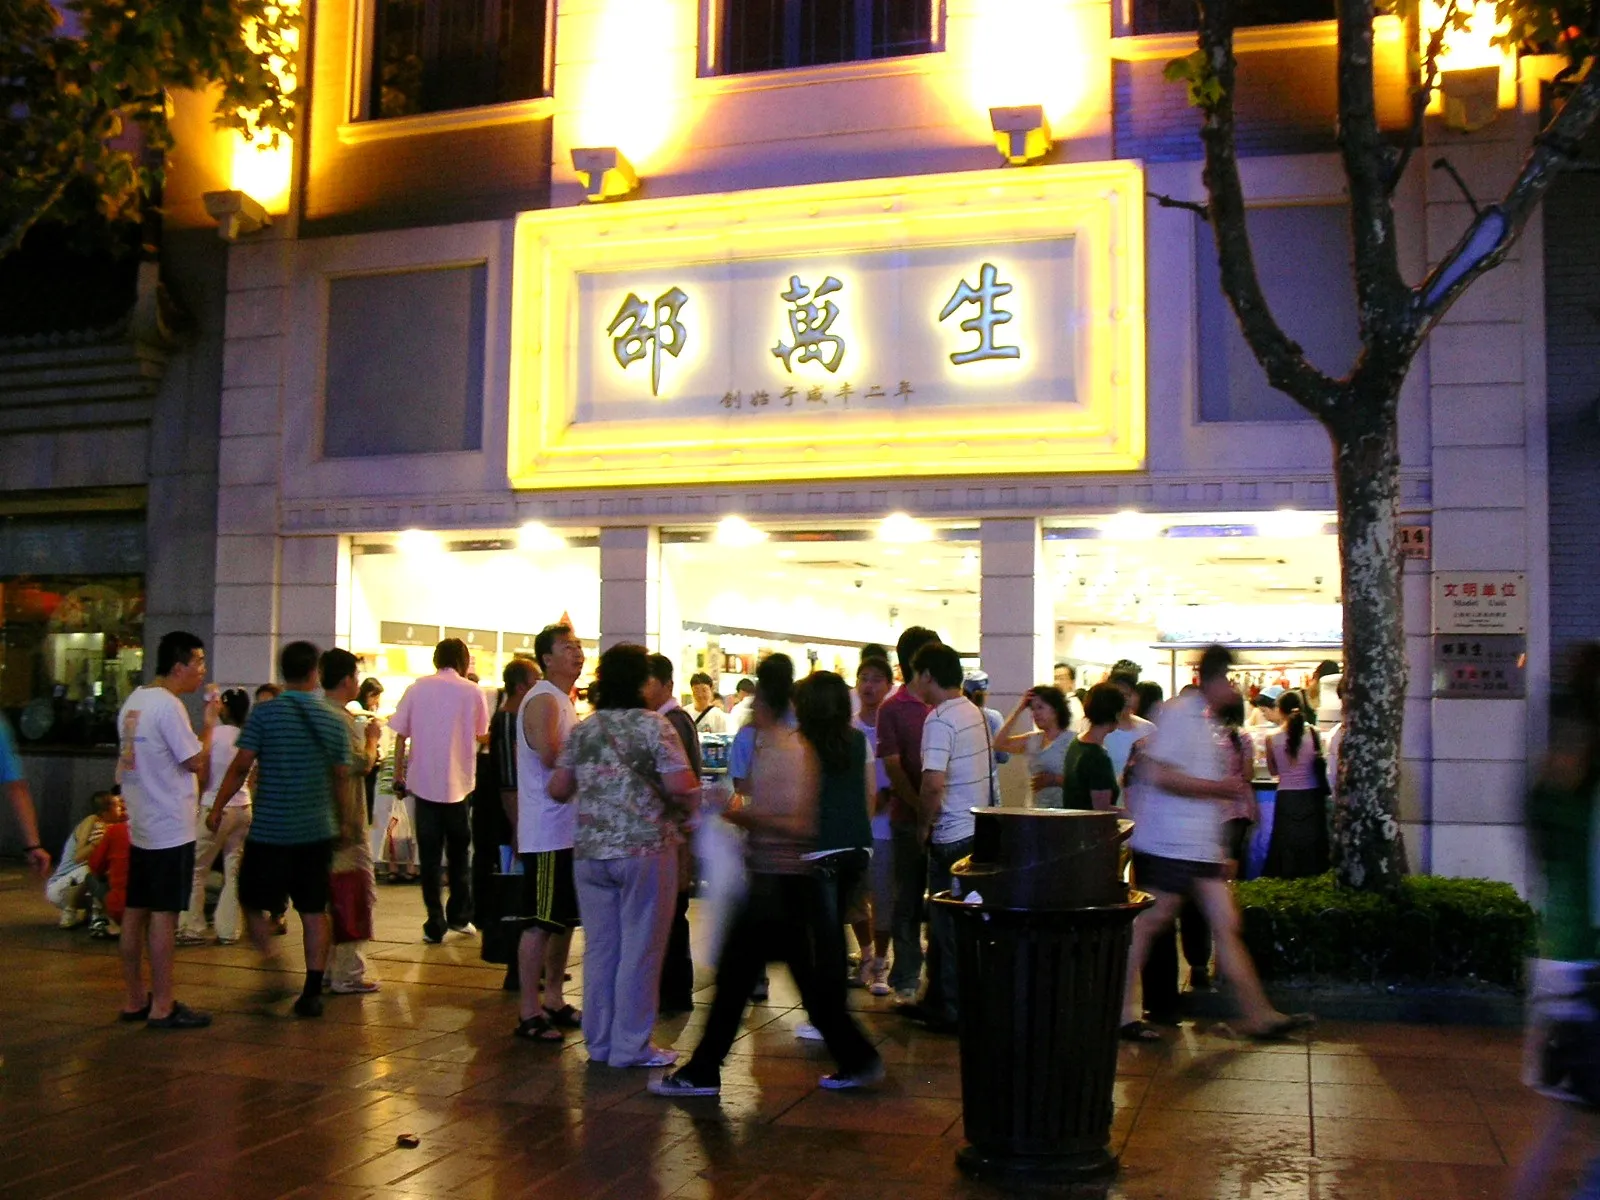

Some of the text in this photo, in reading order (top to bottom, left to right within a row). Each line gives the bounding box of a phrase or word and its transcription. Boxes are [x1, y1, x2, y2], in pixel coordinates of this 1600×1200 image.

[606, 262, 1021, 397] 邵萬生
[1443, 582, 1517, 597] 文明单位
